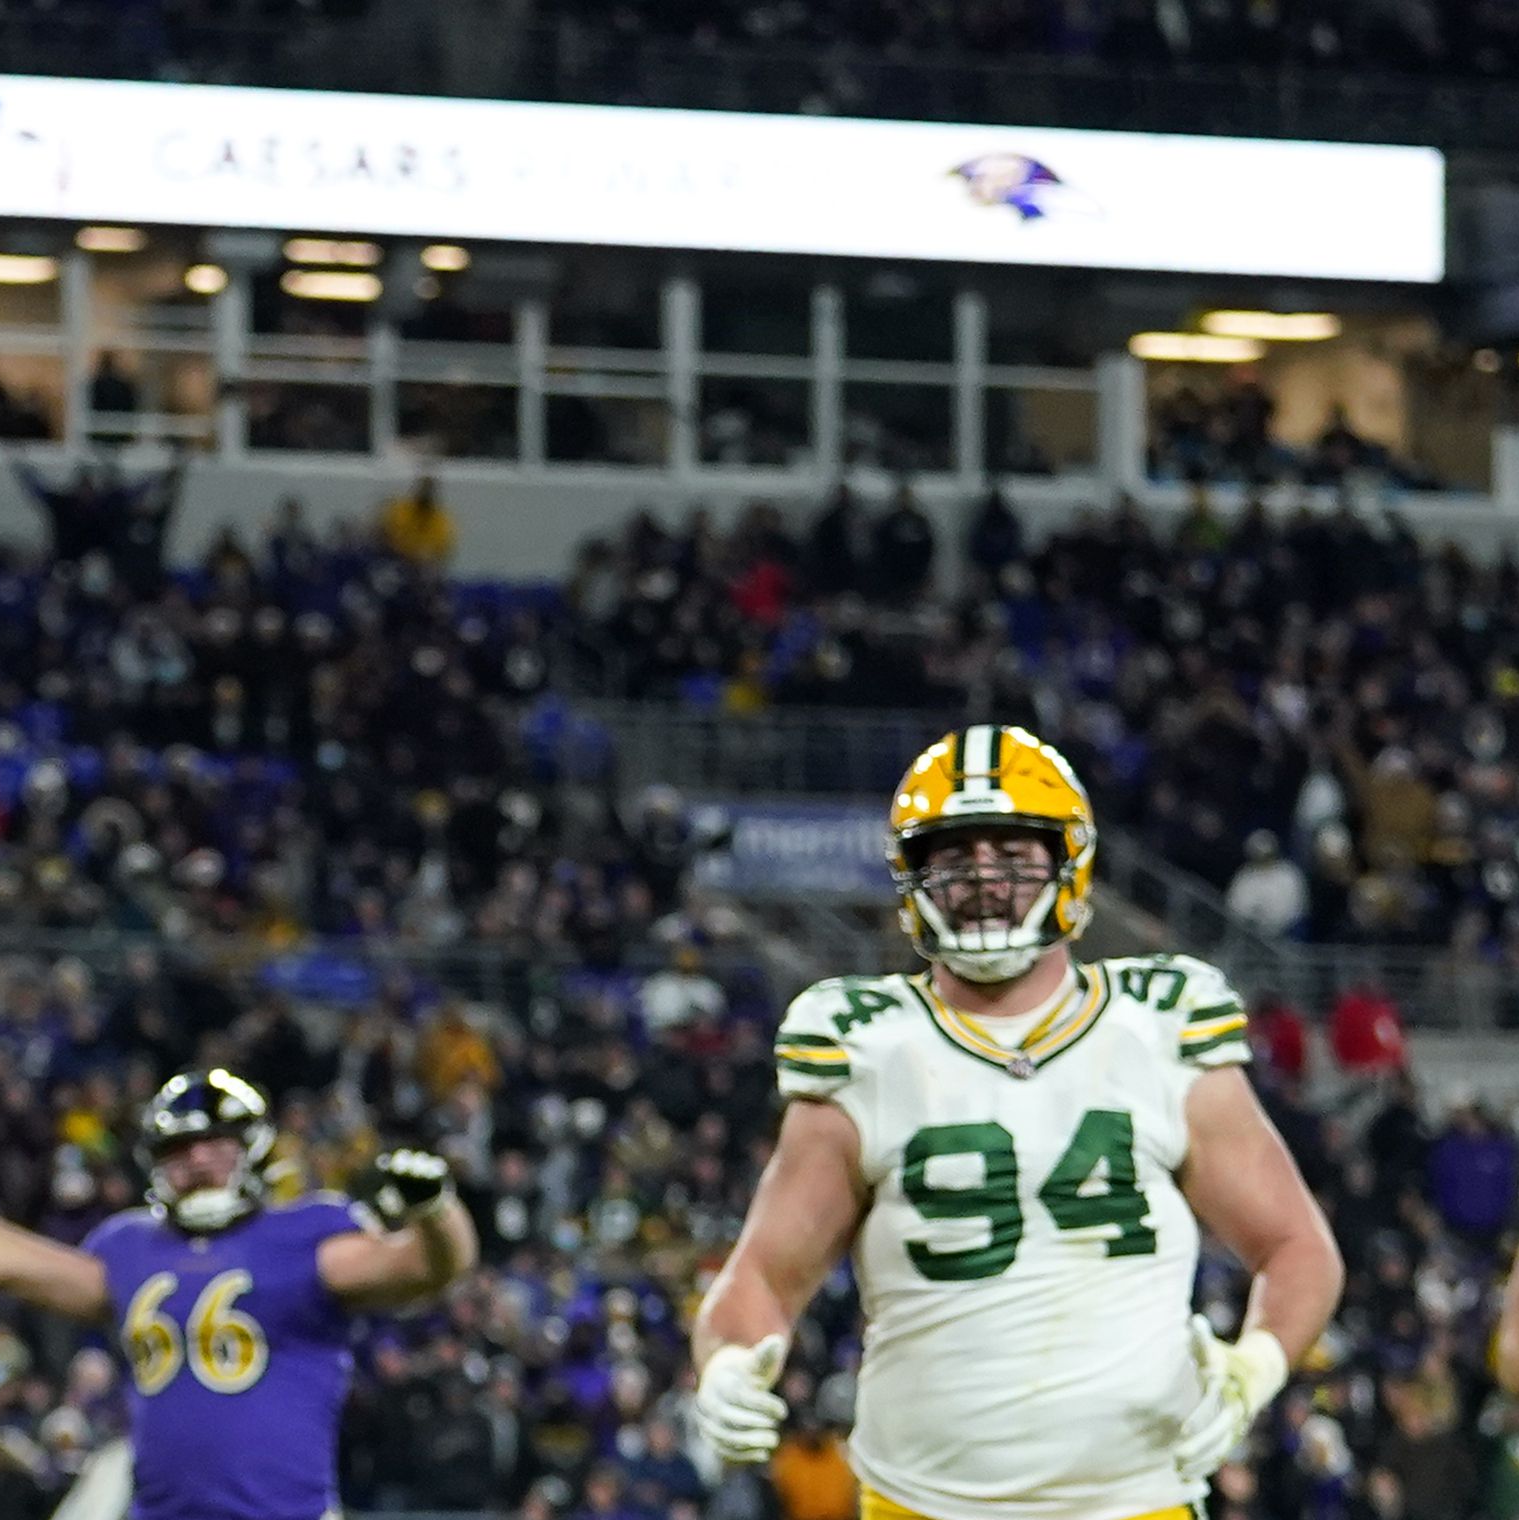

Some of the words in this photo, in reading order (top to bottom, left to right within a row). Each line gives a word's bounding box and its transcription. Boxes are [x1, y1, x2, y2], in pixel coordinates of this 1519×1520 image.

[152, 128, 470, 194] CAESARS
[902, 1108, 1157, 1281] 94
[121, 1268, 270, 1397] 66
